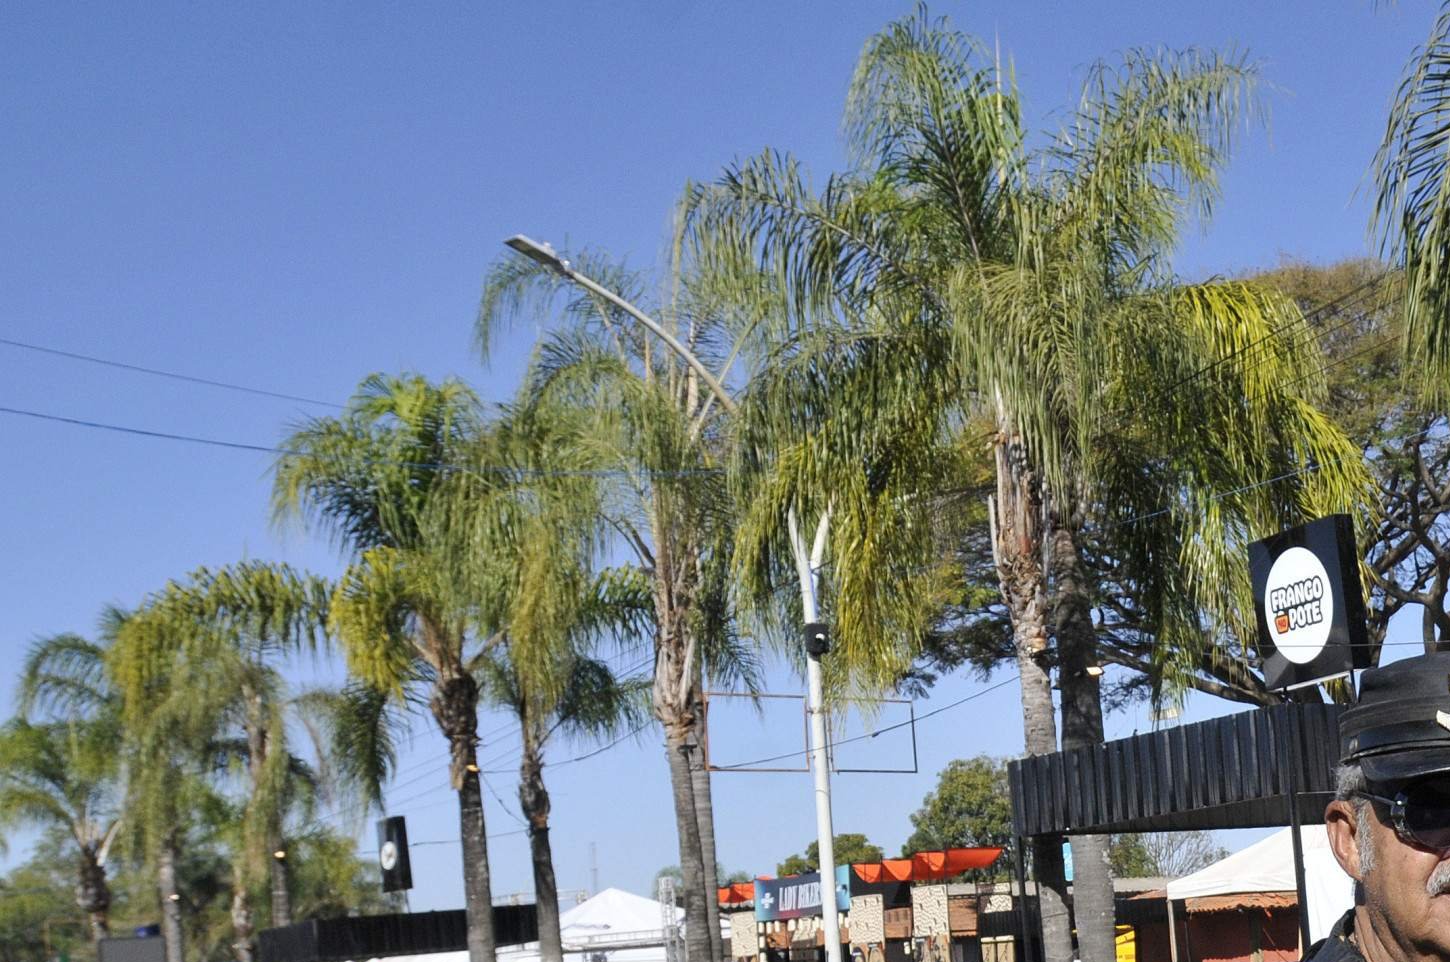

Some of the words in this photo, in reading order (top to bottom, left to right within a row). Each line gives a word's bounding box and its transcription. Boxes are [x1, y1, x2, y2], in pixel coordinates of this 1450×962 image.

[1271, 575, 1323, 613] FRANGO
[1288, 600, 1323, 630] POTE
[779, 885, 798, 911] LADY
